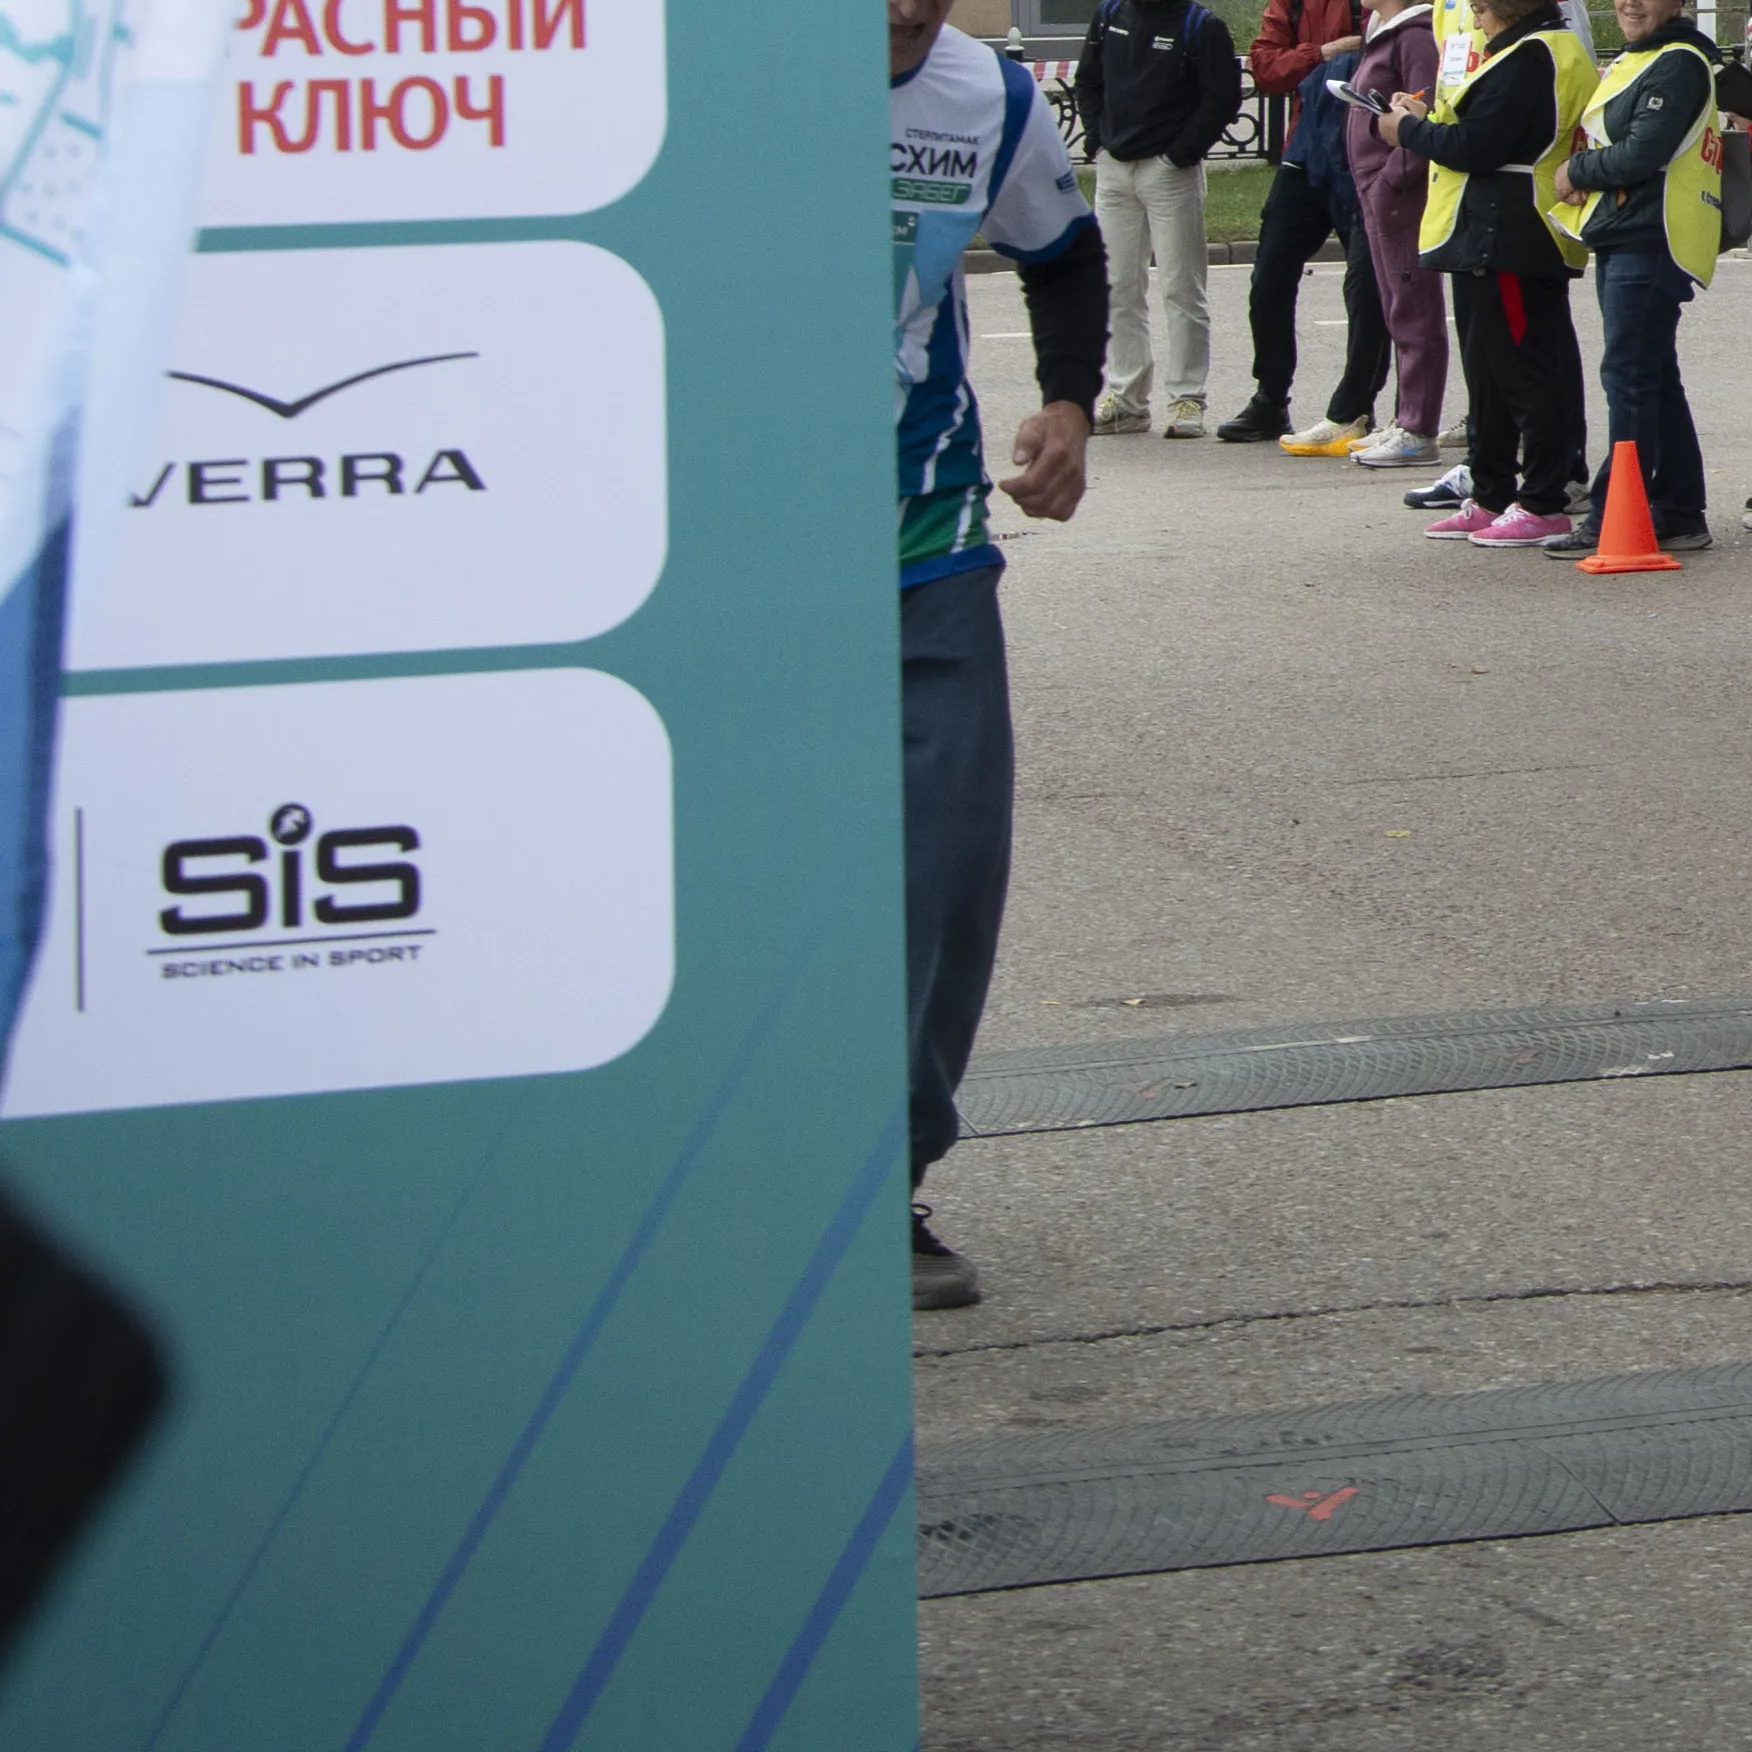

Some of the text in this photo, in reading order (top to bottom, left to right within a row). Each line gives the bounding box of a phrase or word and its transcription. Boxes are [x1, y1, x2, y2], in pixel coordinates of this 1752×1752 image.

[237, 74, 505, 155] КЛЮЧ
[129, 449, 487, 507] VERRA
[161, 945, 423, 979] SCIENCE IN SPORT
